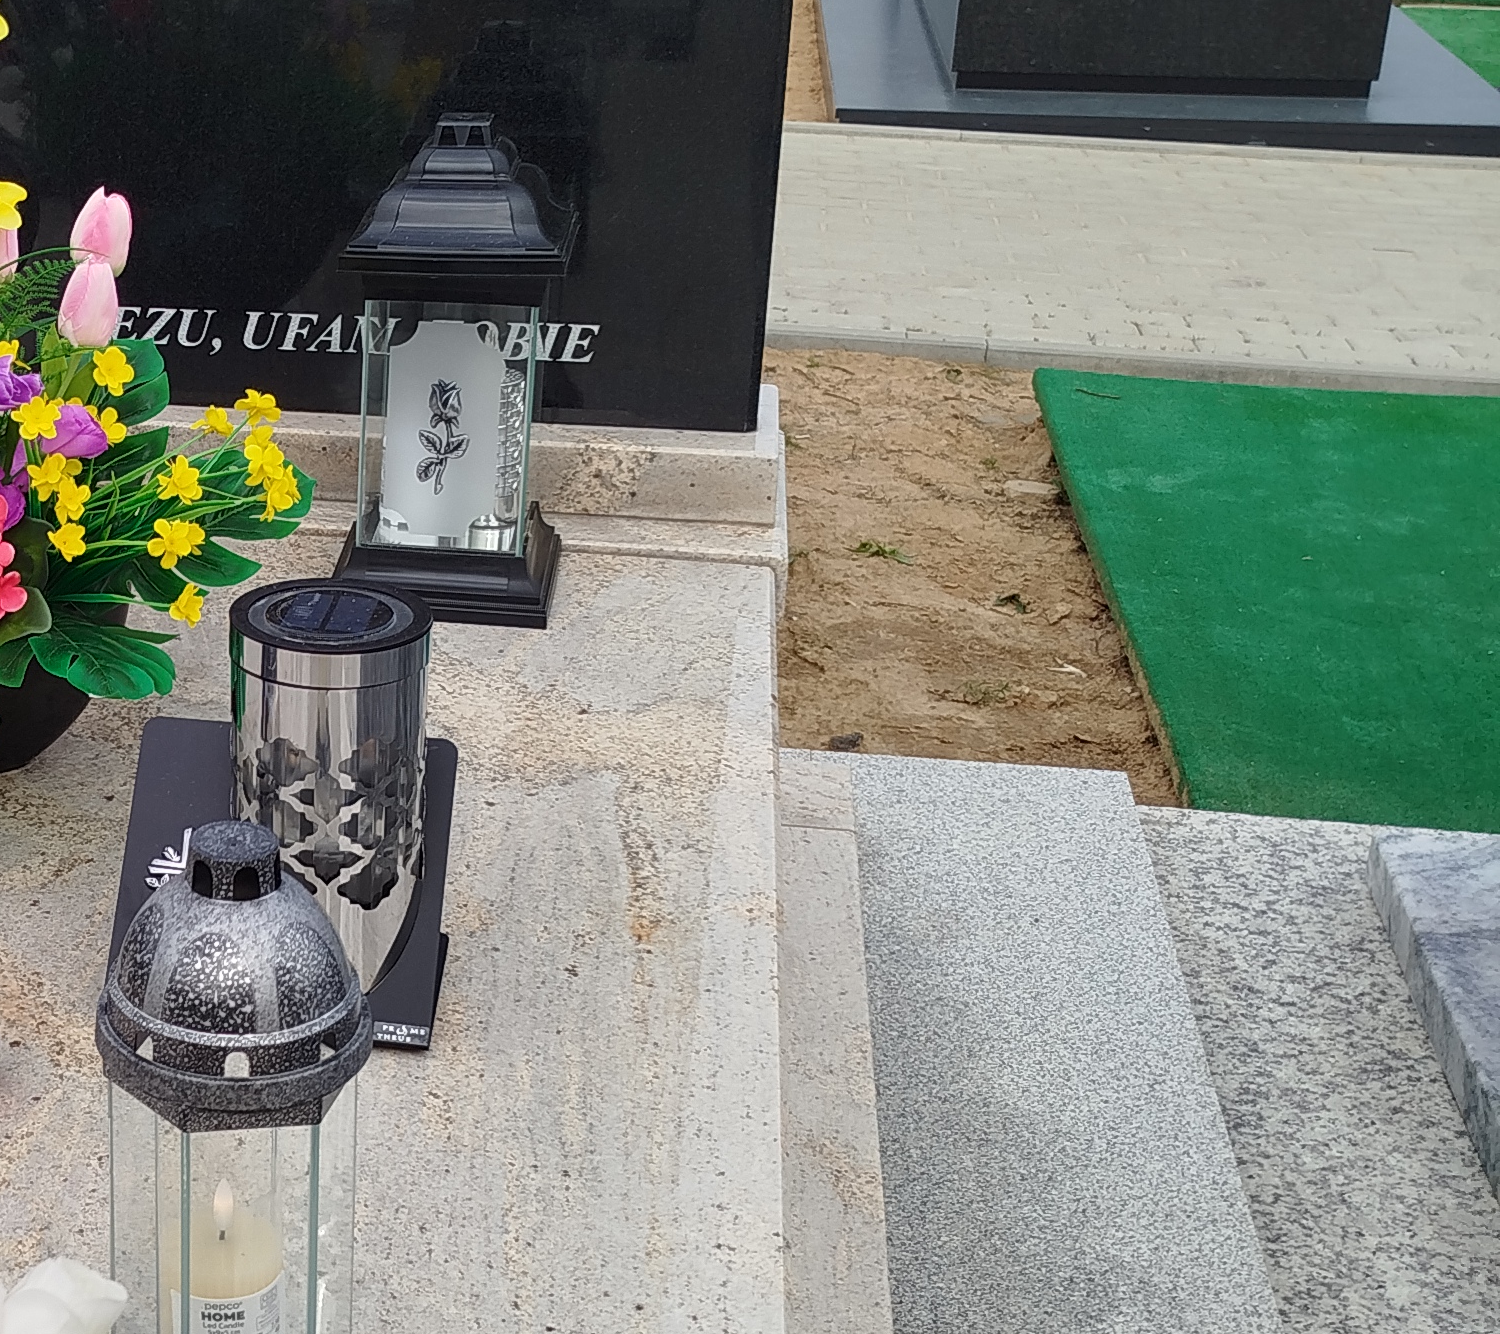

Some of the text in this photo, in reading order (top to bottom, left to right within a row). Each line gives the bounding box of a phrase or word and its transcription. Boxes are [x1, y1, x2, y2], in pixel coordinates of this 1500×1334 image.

[111, 306, 222, 356] EZU,
[201, 1310, 245, 1321] HOME
[202, 1321, 245, 1330] Led Candle
